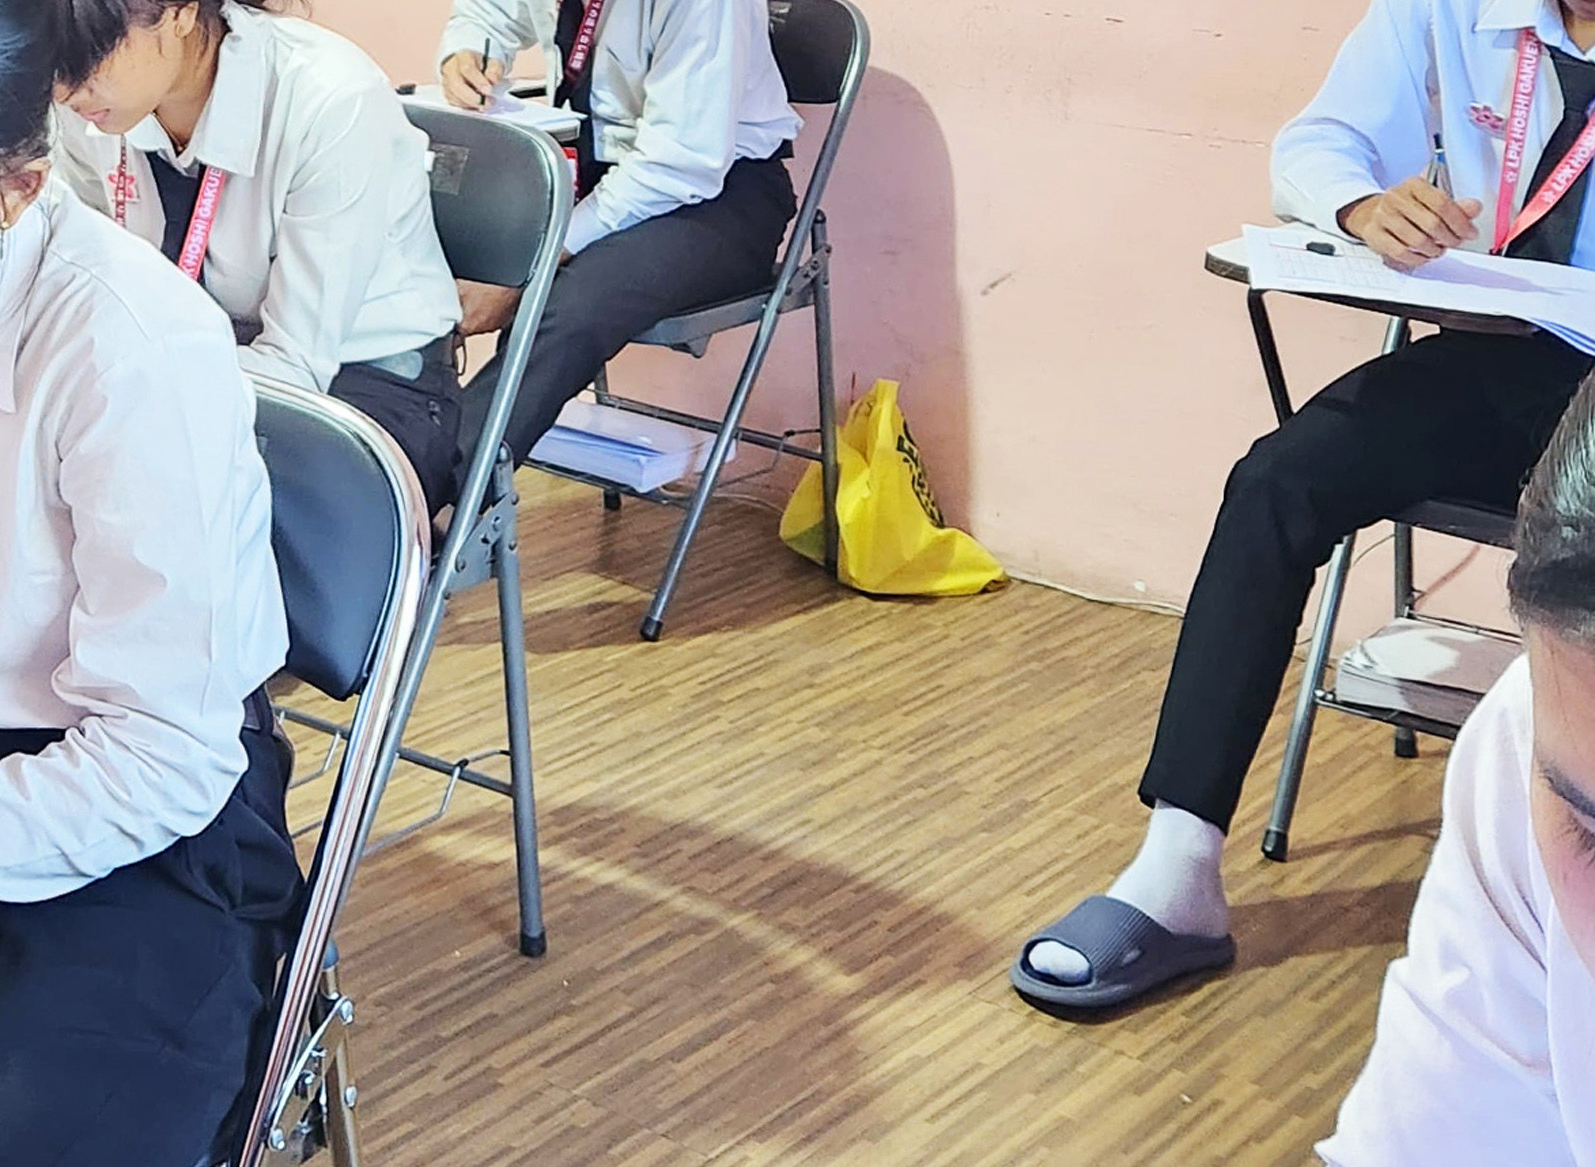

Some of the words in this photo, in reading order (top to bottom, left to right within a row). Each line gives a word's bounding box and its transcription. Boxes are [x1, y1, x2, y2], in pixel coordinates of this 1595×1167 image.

[1511, 95, 1530, 144] HOSHI
[1507, 143, 1523, 170] LPK
[183, 218, 208, 267] HOSHI
[198, 166, 223, 220] GAKUE
